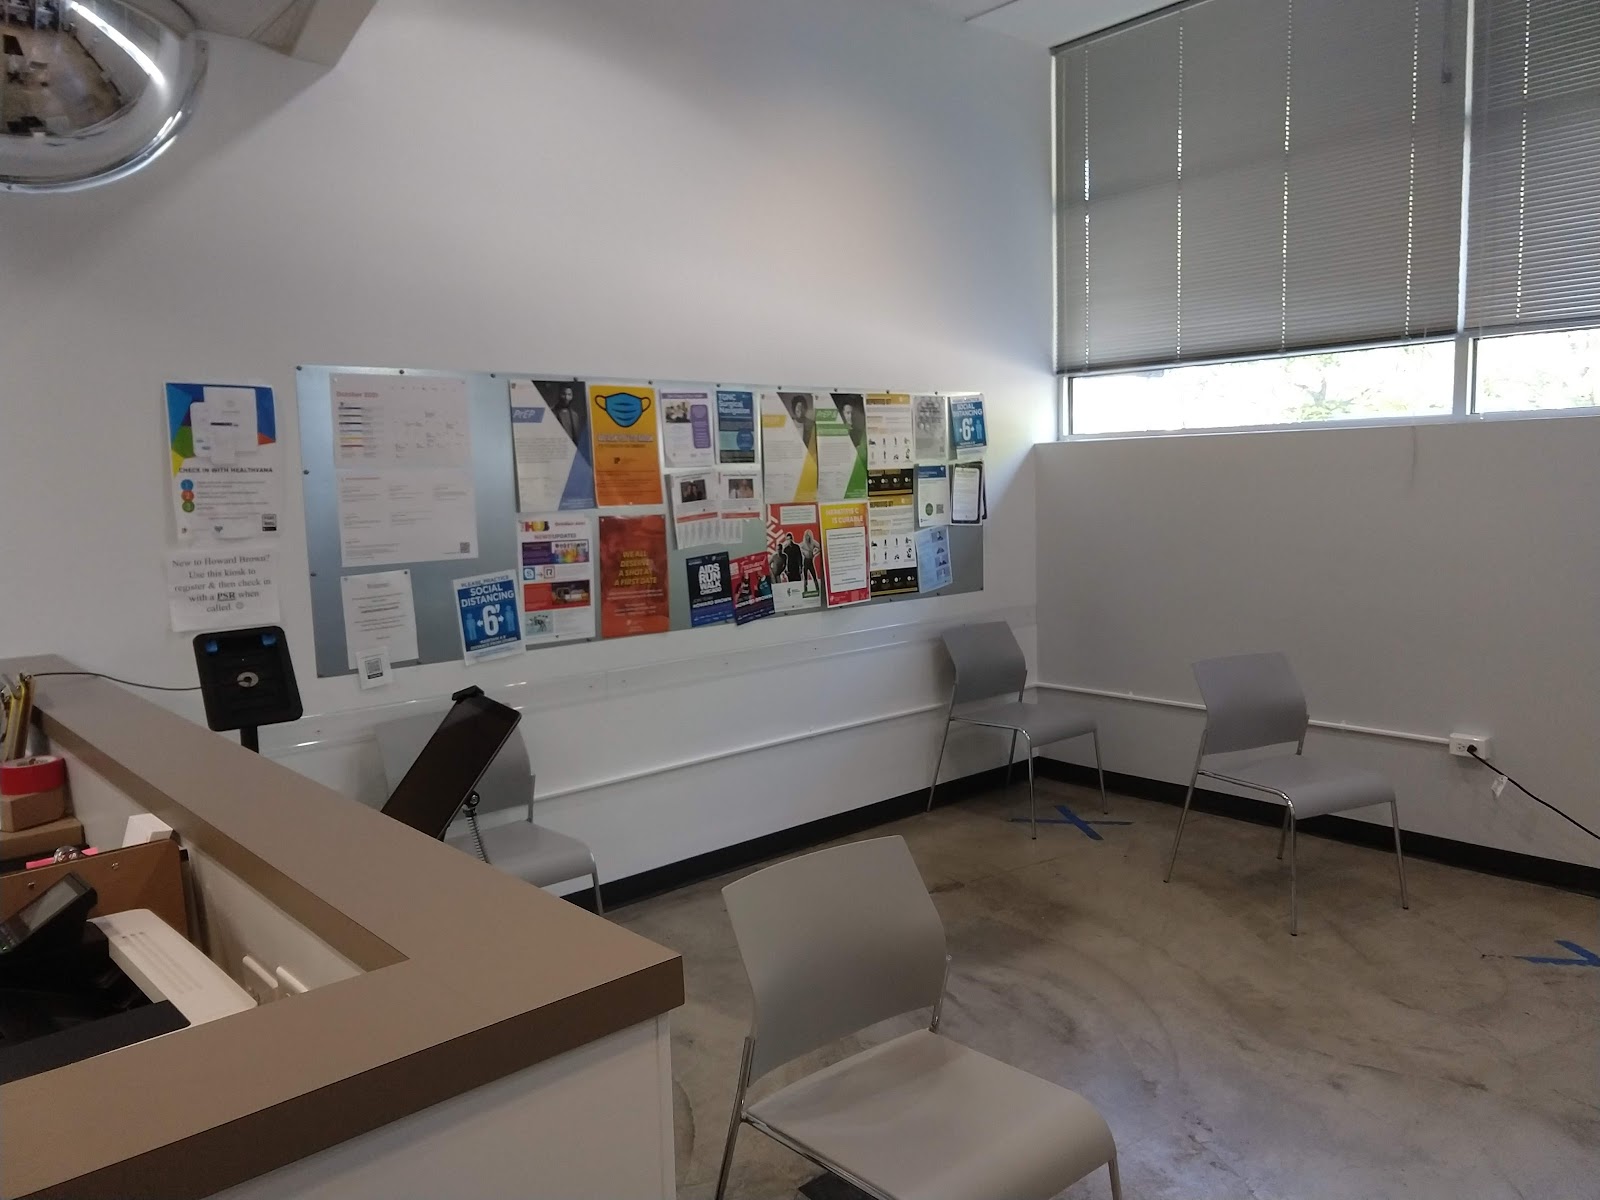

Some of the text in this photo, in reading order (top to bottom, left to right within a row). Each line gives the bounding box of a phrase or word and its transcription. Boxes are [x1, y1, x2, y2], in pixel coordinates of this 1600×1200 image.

[512, 409, 536, 420] PrEP
[204, 556, 237, 566] Howard
[239, 554, 271, 563] Brown?
[189, 571, 205, 579] Use
[207, 570, 222, 578] this
[224, 568, 246, 577] kiosk
[699, 563, 720, 574] AIDS
[699, 571, 721, 584] RUN
[174, 583, 206, 592] register
[208, 581, 216, 590] &
[238, 578, 261, 587] check
[470, 583, 504, 597] SOCIAL
[700, 580, 722, 591] WALK
[189, 593, 208, 602] with
[217, 591, 236, 601] PSR
[238, 590, 260, 598] when
[461, 589, 515, 608] DISTANCING
[482, 603, 501, 636] 6'
